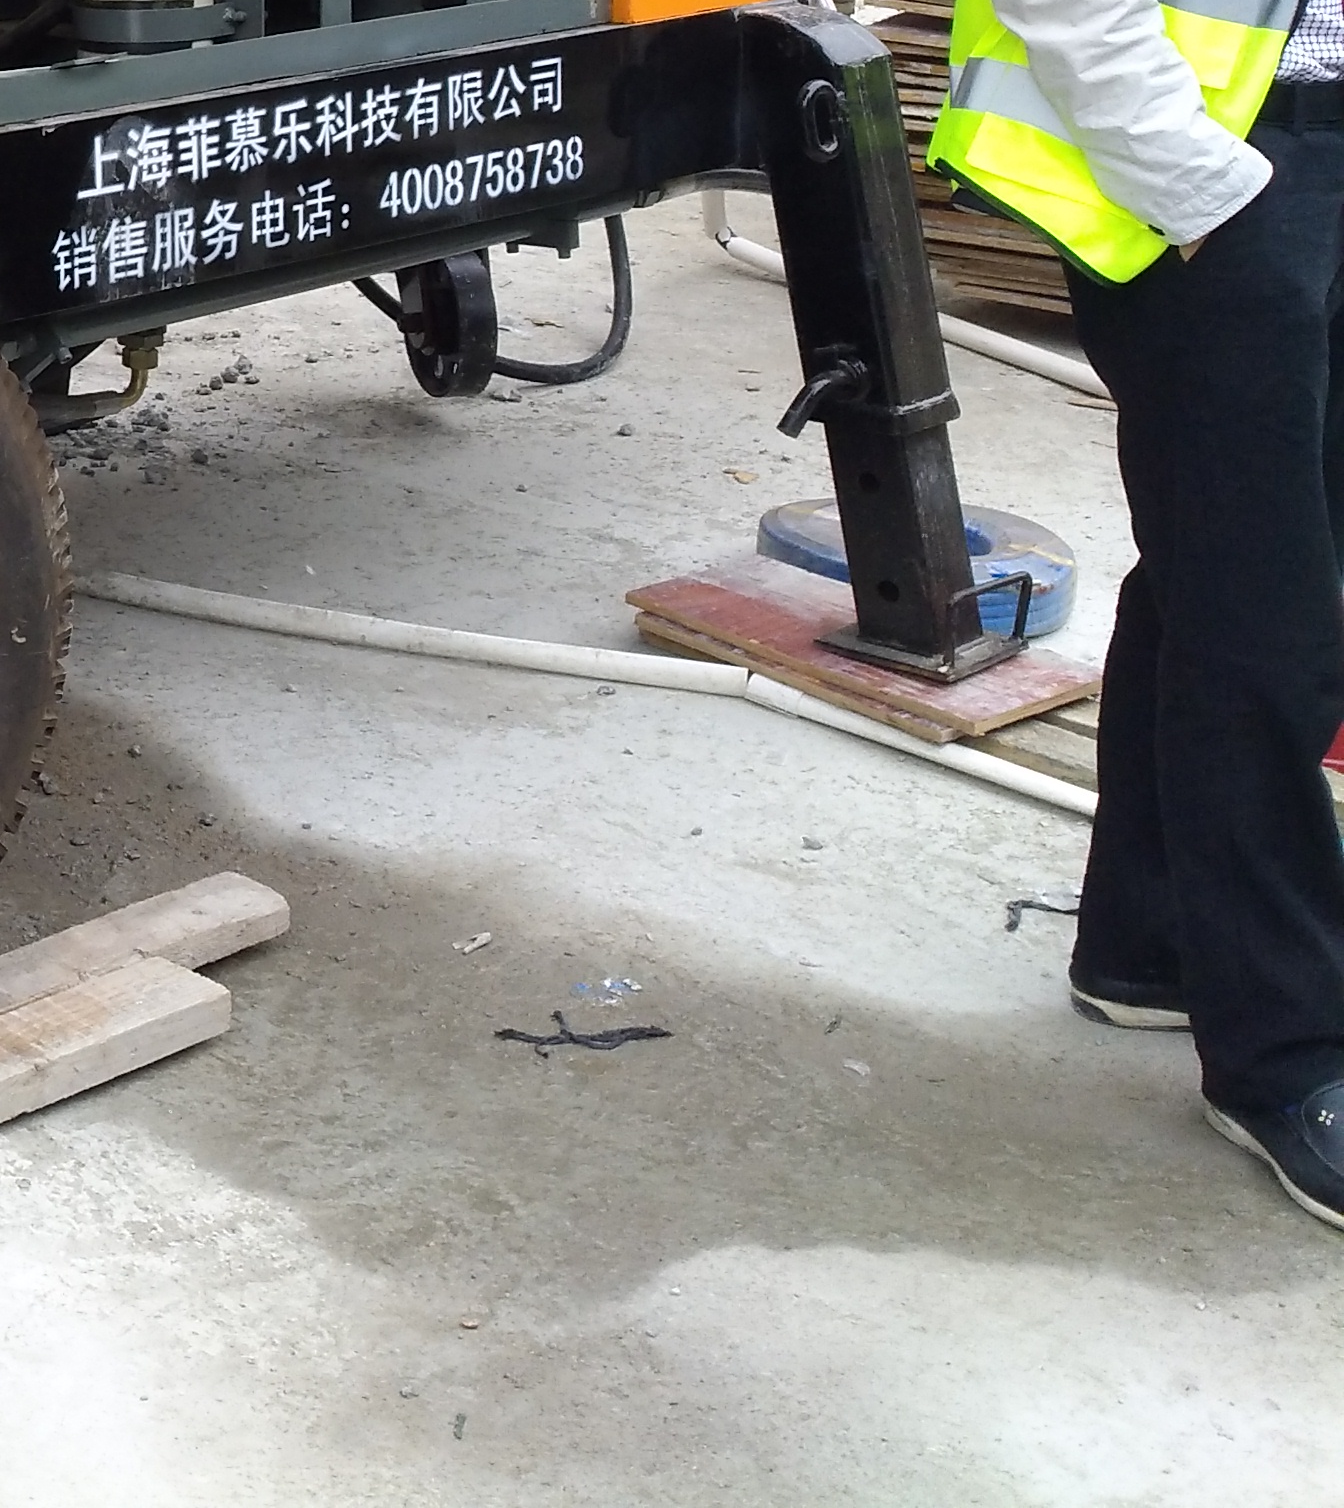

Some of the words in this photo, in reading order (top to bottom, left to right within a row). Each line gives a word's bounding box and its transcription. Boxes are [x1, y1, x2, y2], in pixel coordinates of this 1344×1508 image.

[76, 55, 564, 201] 上海菲慕乐科技有限公司
